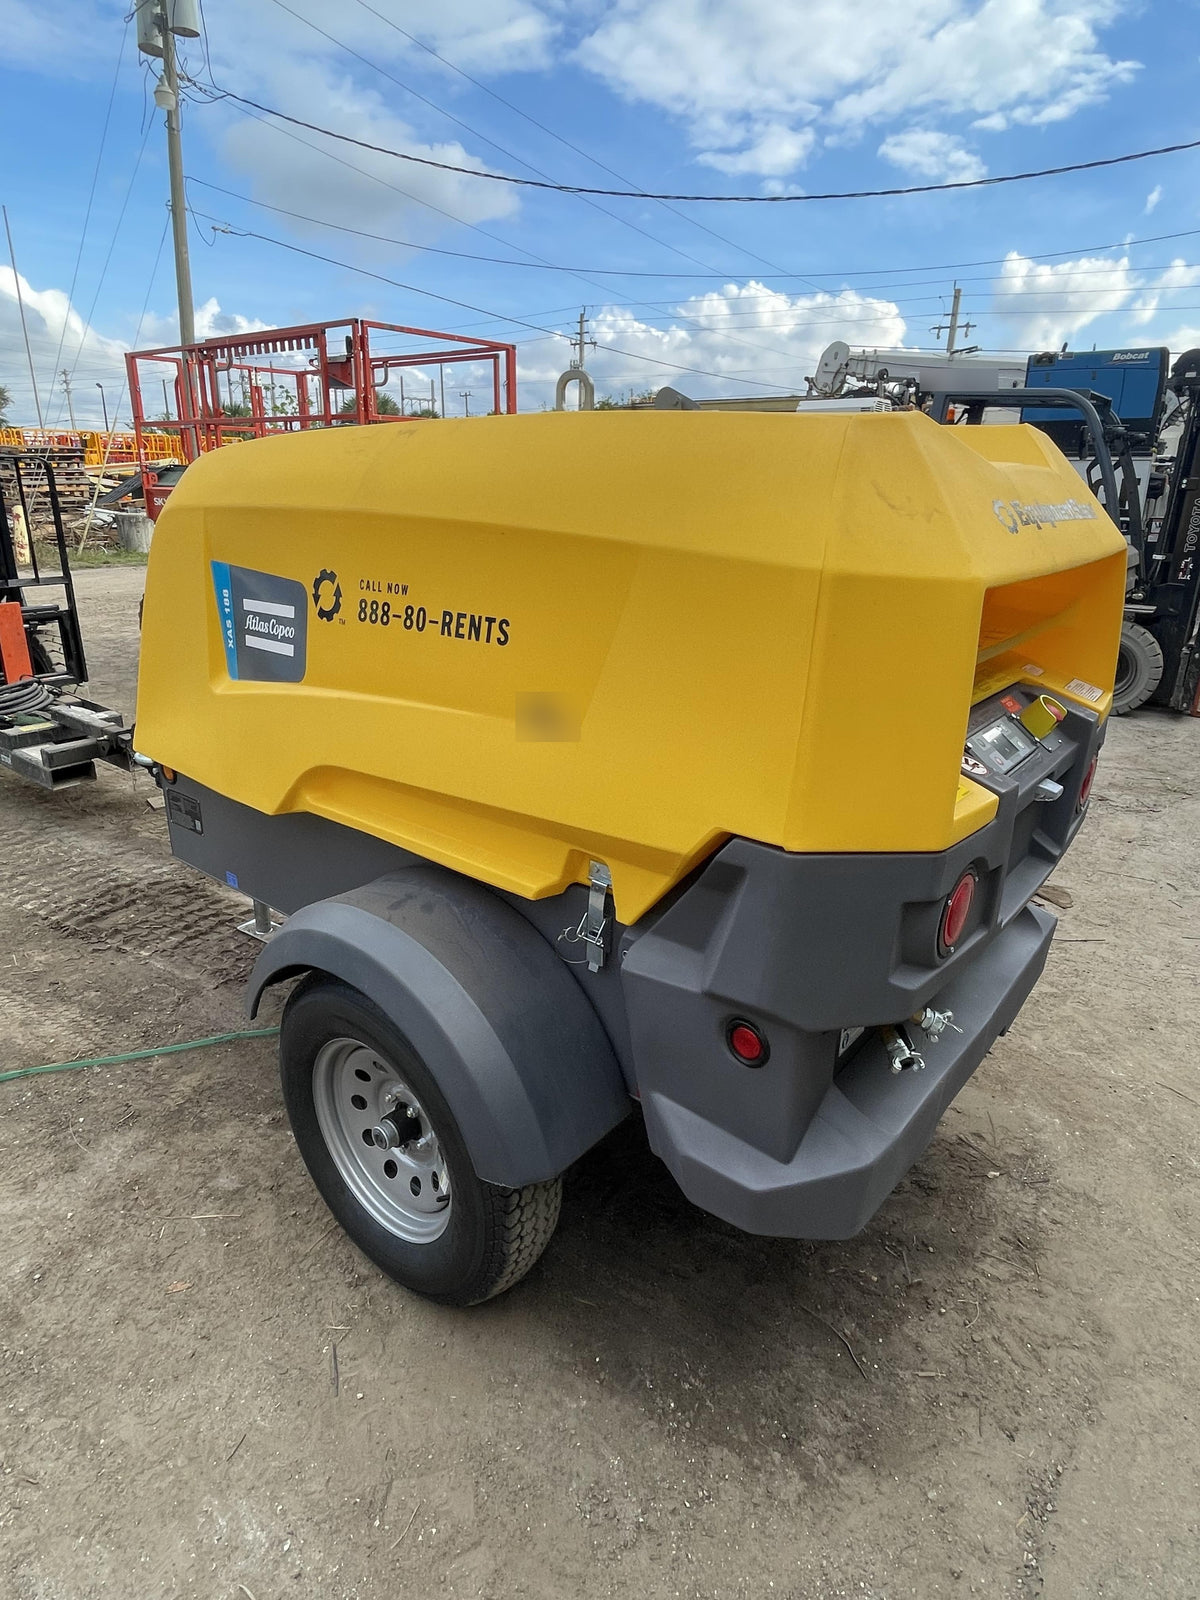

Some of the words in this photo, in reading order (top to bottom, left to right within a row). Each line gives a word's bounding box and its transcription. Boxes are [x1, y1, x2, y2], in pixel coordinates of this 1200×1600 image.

[1112, 352, 1149, 361] Bobcat
[359, 579, 382, 593] CALL
[387, 582, 409, 596] NOW
[222, 589, 230, 614] 188
[225, 619, 234, 649] XAS
[358, 598, 511, 647] 888-80-RENTS
